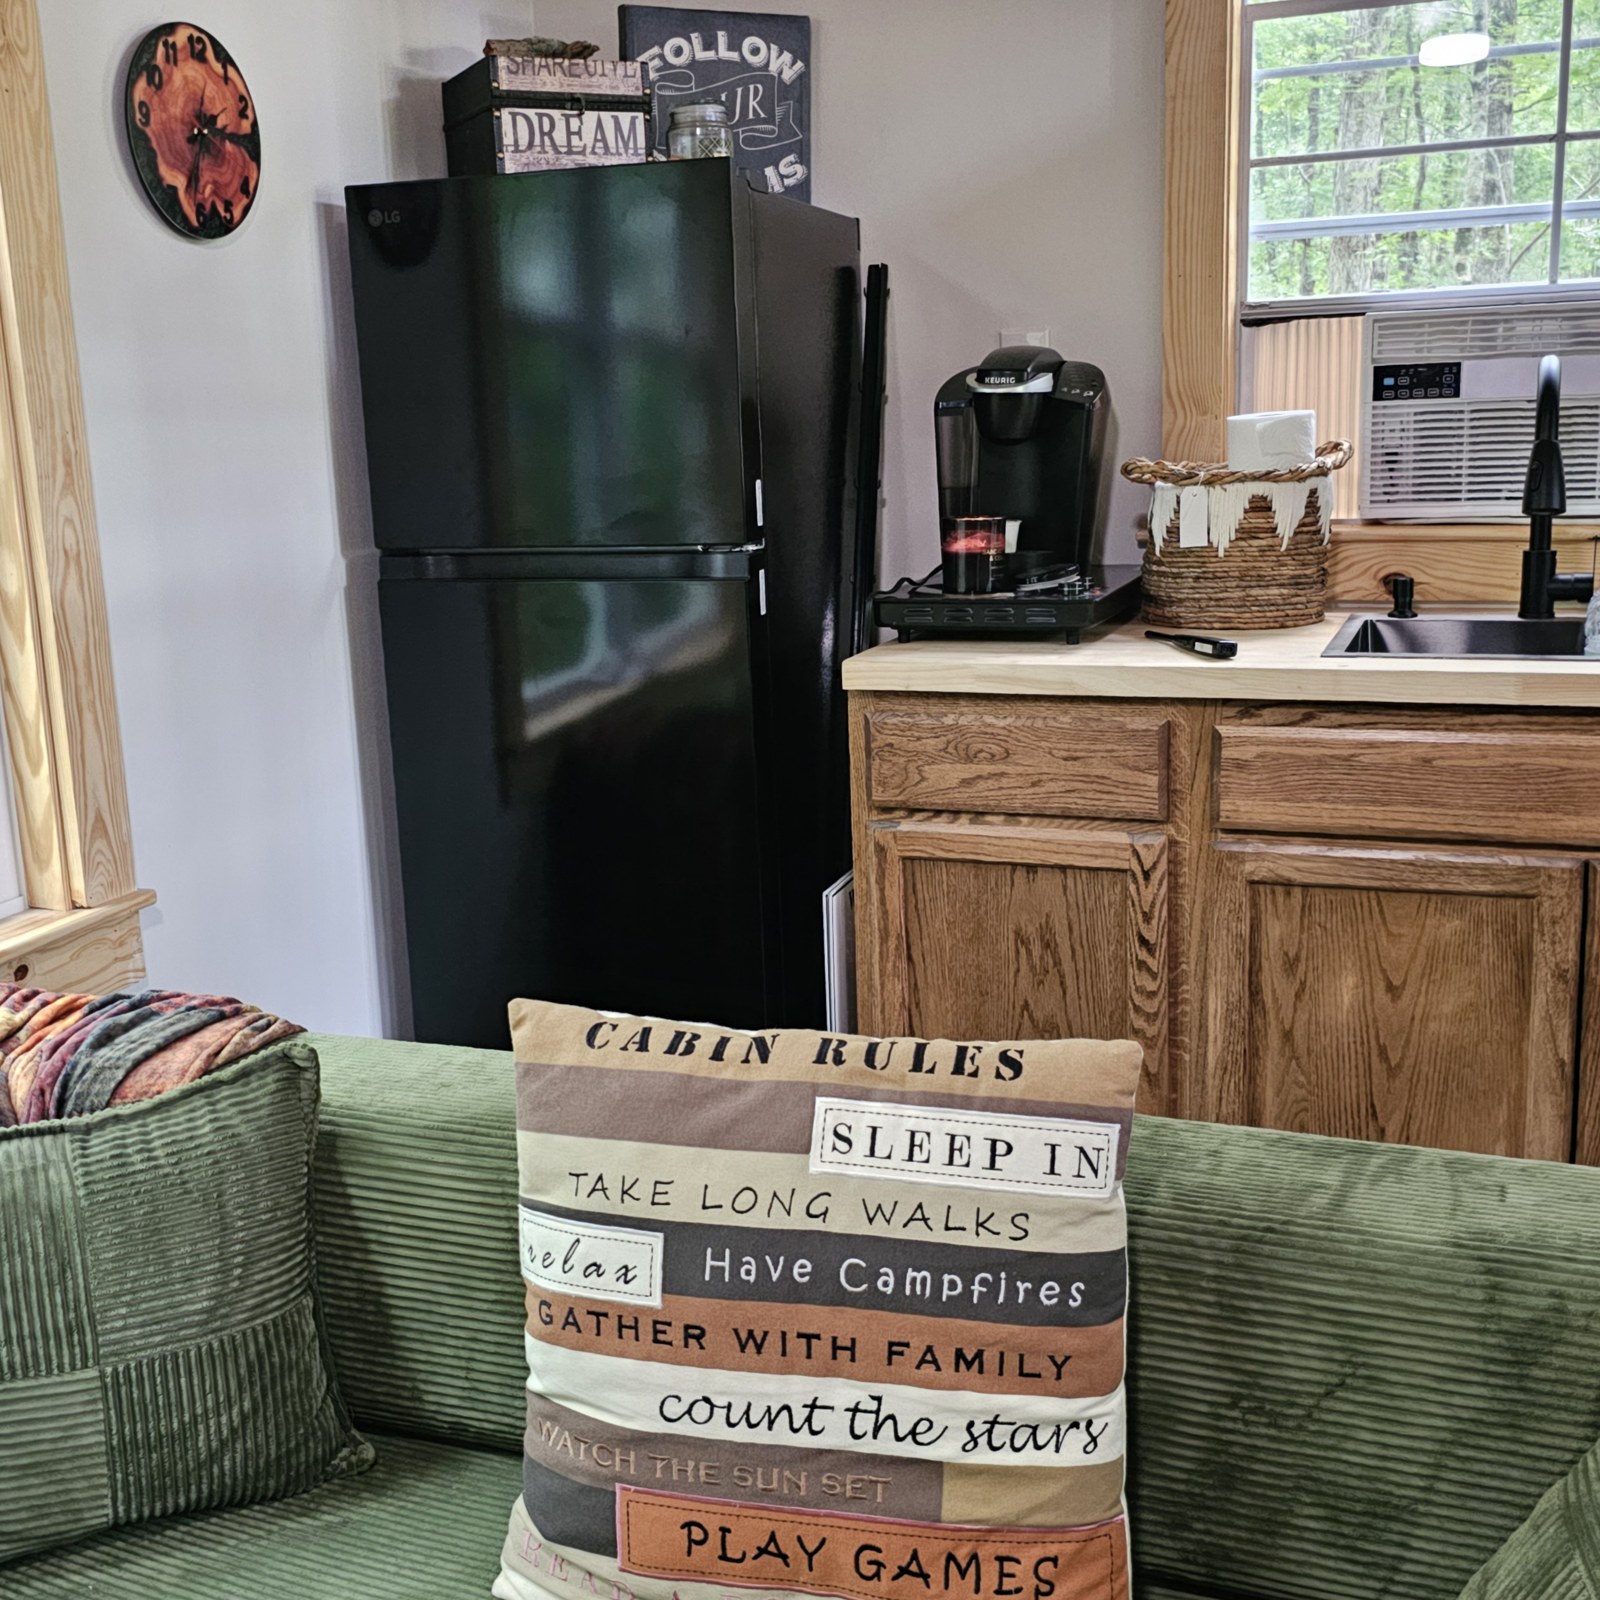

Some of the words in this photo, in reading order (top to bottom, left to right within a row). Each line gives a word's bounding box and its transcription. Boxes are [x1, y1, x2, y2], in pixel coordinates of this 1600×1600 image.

[162, 38, 178, 67] 11
[187, 33, 207, 63] 12
[637, 31, 805, 85] FOLLOW
[138, 101, 150, 127] 9
[239, 95, 249, 119] 2
[508, 111, 643, 156] DREAM
[223, 199, 234, 225] 5
[586, 1021, 780, 1064] CABIN
[812, 1037, 1024, 1081] RULES
[831, 1122, 1013, 1171] SLEEP
[1043, 1143, 1104, 1179] IN
[568, 1172, 674, 1206] TAKE
[702, 1184, 832, 1223] LONG
[862, 1198, 1029, 1241] WALKS
[527, 1238, 637, 1284] relax
[704, 1247, 812, 1283] Have
[840, 1258, 1085, 1307] Campfires
[539, 1300, 706, 1350] GATHER
[733, 1328, 856, 1363] WITH
[886, 1340, 1072, 1380] FAMILY
[659, 1394, 834, 1436] count
[844, 1395, 948, 1446] the
[962, 1414, 1108, 1454] stars
[538, 1417, 636, 1475] WATCH
[648, 1453, 721, 1484] THE
[733, 1466, 808, 1495] SUN
[822, 1473, 892, 1503] SET
[680, 1521, 826, 1572] PLAY
[854, 1544, 1058, 1600] GAMES
